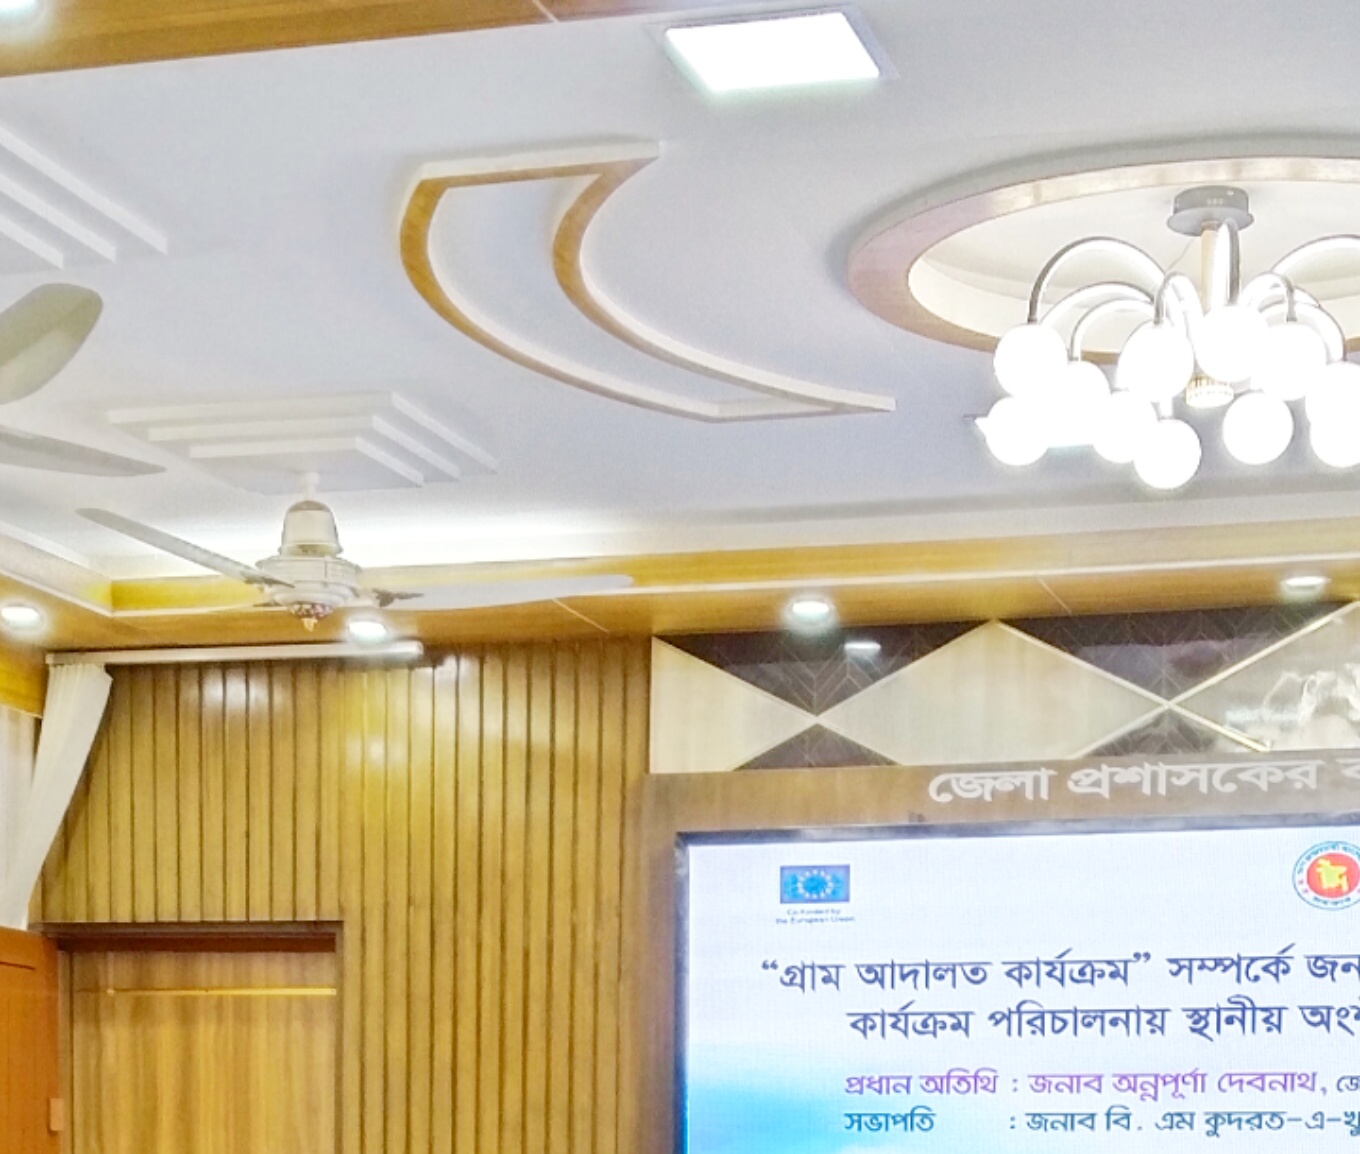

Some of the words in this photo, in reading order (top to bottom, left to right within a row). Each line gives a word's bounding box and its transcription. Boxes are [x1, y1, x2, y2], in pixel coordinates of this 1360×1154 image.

[928, 767, 1057, 802] জেলা
[1067, 759, 1325, 799] প্রশাসকের
[855, 958, 989, 990] আদালত
[1169, 944, 1295, 981] সম্পর্কে
[846, 1000, 973, 1041] কার্যক্রম
[987, 999, 1172, 1040] পরিচালনায়
[1185, 995, 1286, 1041] স্থানীয়
[844, 1073, 911, 1096] প্রধান
[919, 1067, 998, 1095] অতিথি
[1028, 1073, 1103, 1095] জনাব
[1112, 1068, 1207, 1101] অন্নপূর্ণা
[1217, 1072, 1327, 1097] দেবনাথ,
[843, 1105, 936, 1132] সভাপতি
[1026, 1110, 1095, 1131] জনাব
[1154, 1110, 1194, 1131] এম
